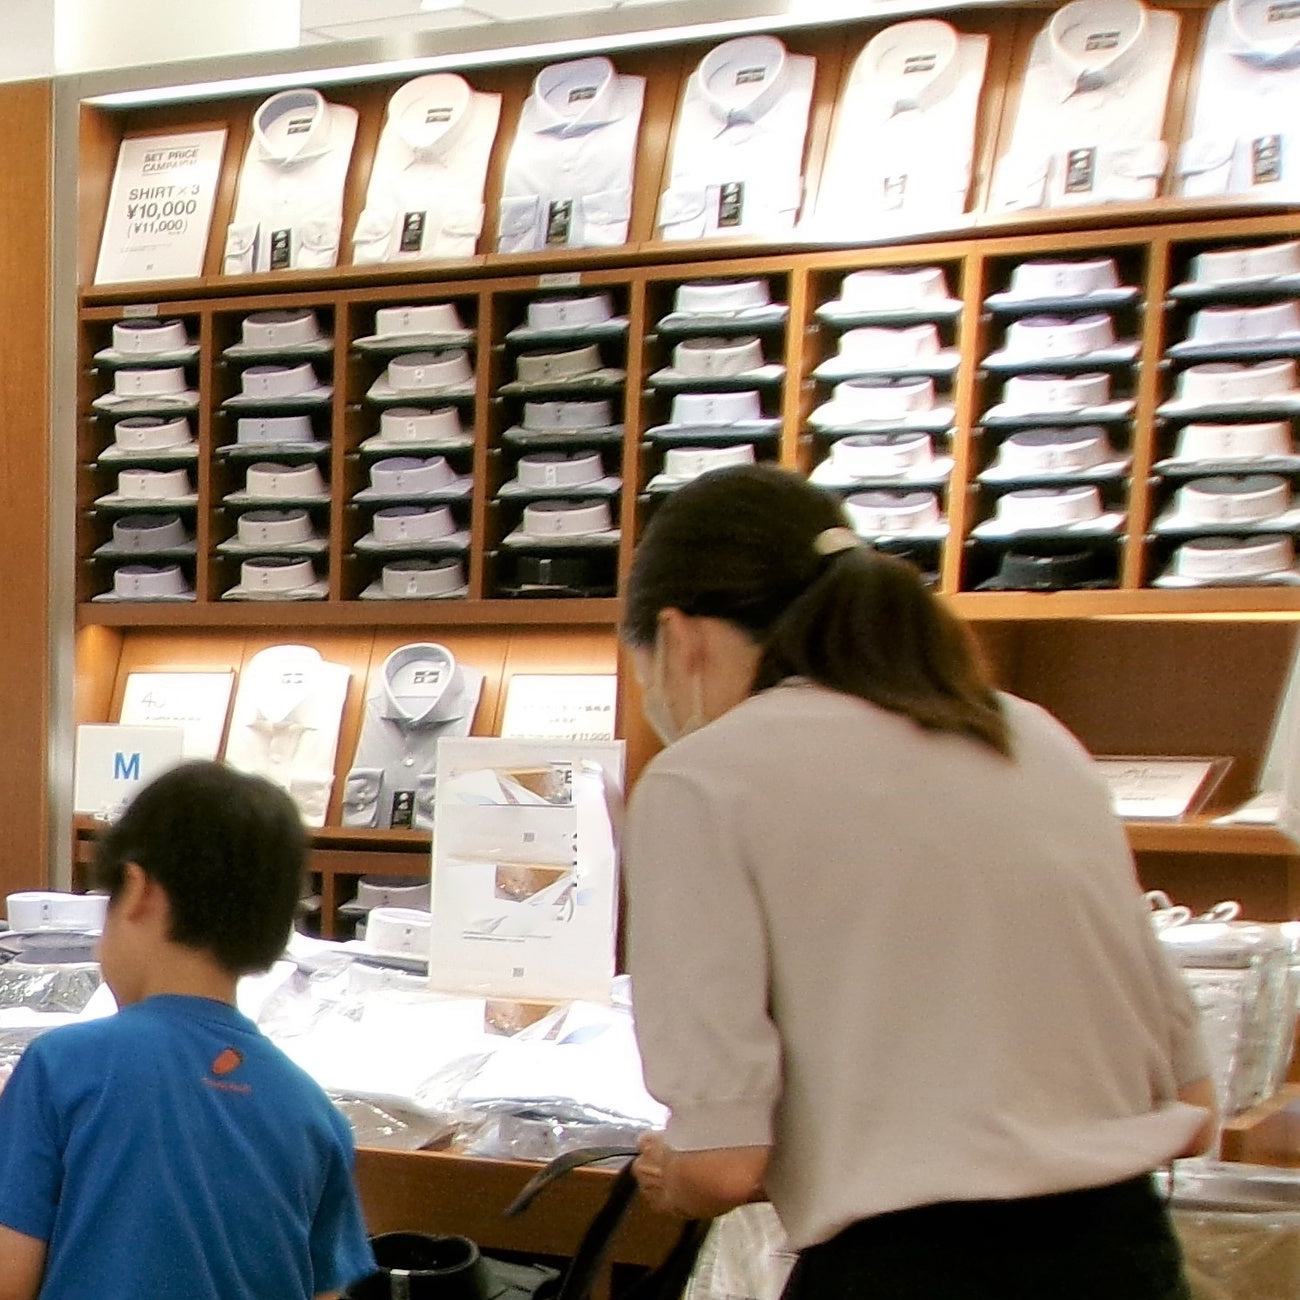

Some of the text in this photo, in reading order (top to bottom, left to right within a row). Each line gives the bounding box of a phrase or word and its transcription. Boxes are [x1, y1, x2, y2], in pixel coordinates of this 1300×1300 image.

[167, 149, 199, 160] PRICE
[129, 186, 175, 200] SHIRT
[191, 184, 200, 195] 3
[127, 200, 197, 220] ¥10,000
[113, 751, 141, 781] M
